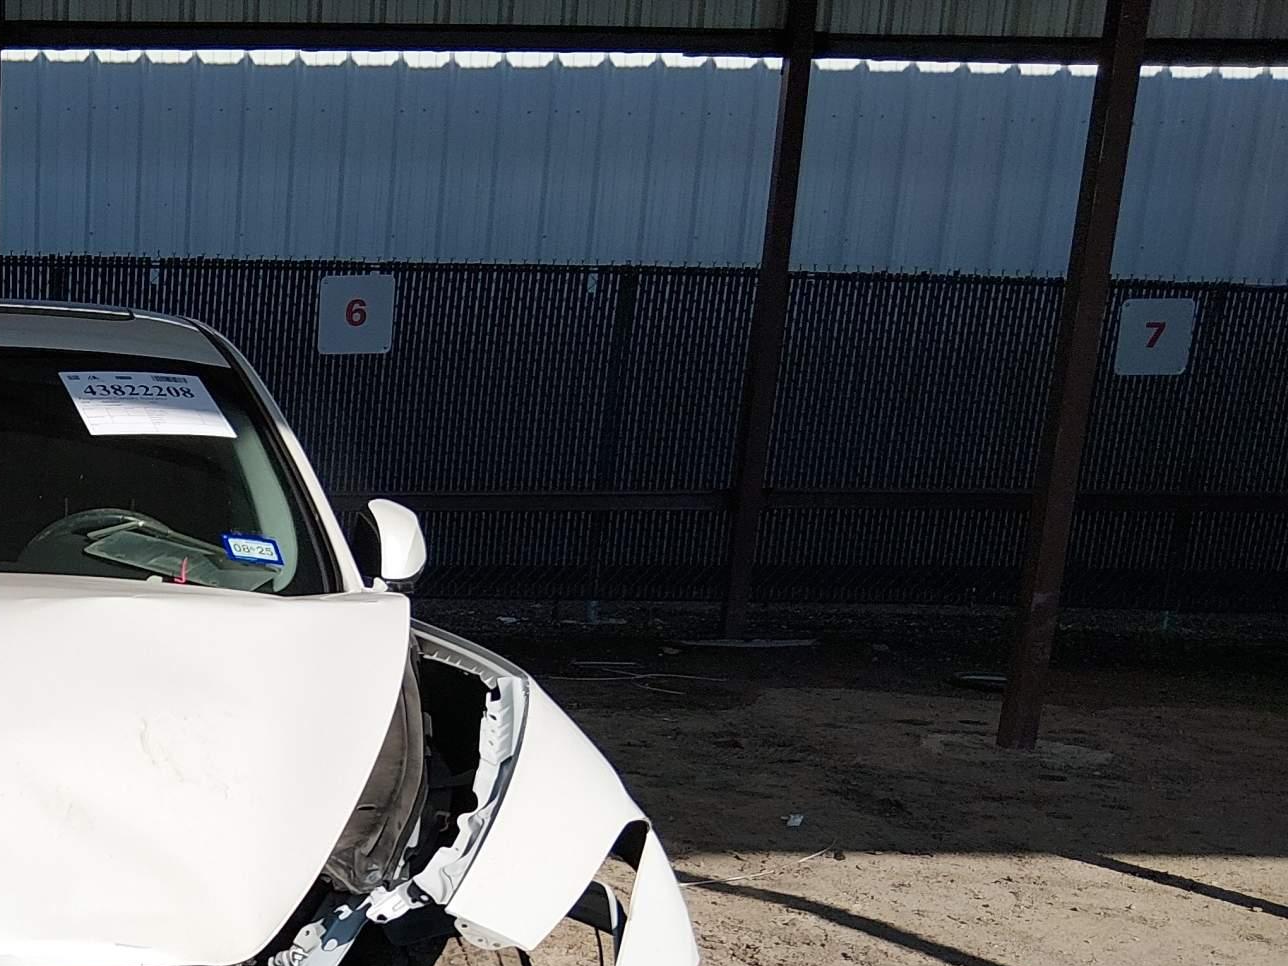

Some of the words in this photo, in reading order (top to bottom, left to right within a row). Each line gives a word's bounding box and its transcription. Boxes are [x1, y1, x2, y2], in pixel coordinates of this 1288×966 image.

[345, 298, 367, 327] 6
[1145, 321, 1167, 349] 7
[83, 384, 195, 399] 43822208
